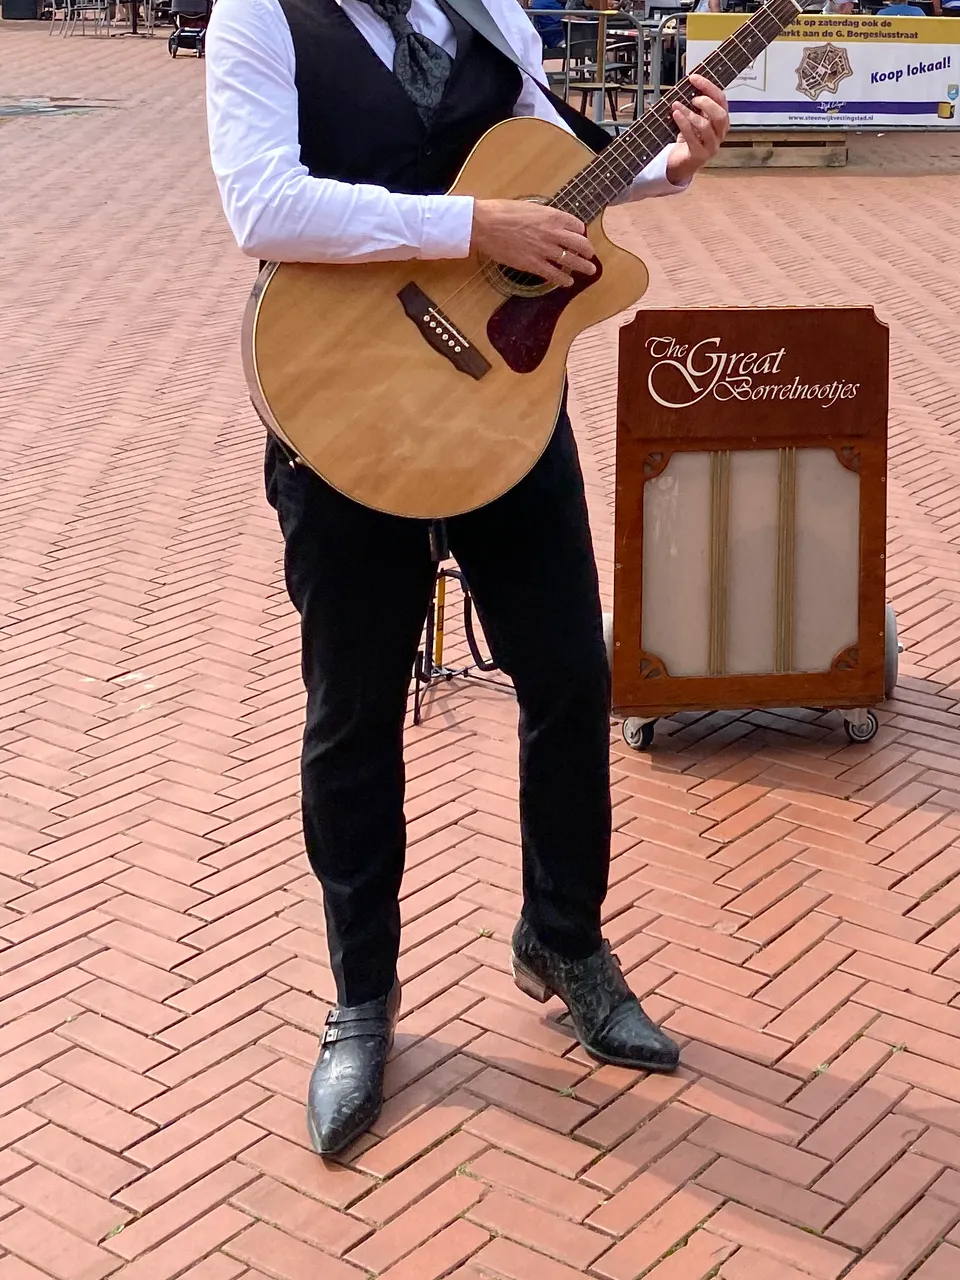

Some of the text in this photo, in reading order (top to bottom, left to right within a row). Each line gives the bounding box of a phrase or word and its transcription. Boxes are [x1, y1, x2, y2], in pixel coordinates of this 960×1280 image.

[818, 19, 860, 28] zaterdag
[870, 55, 951, 84] Koop lokaal!
[645, 336, 787, 409] The Great
[713, 376, 860, 408] Borrelnootjes
